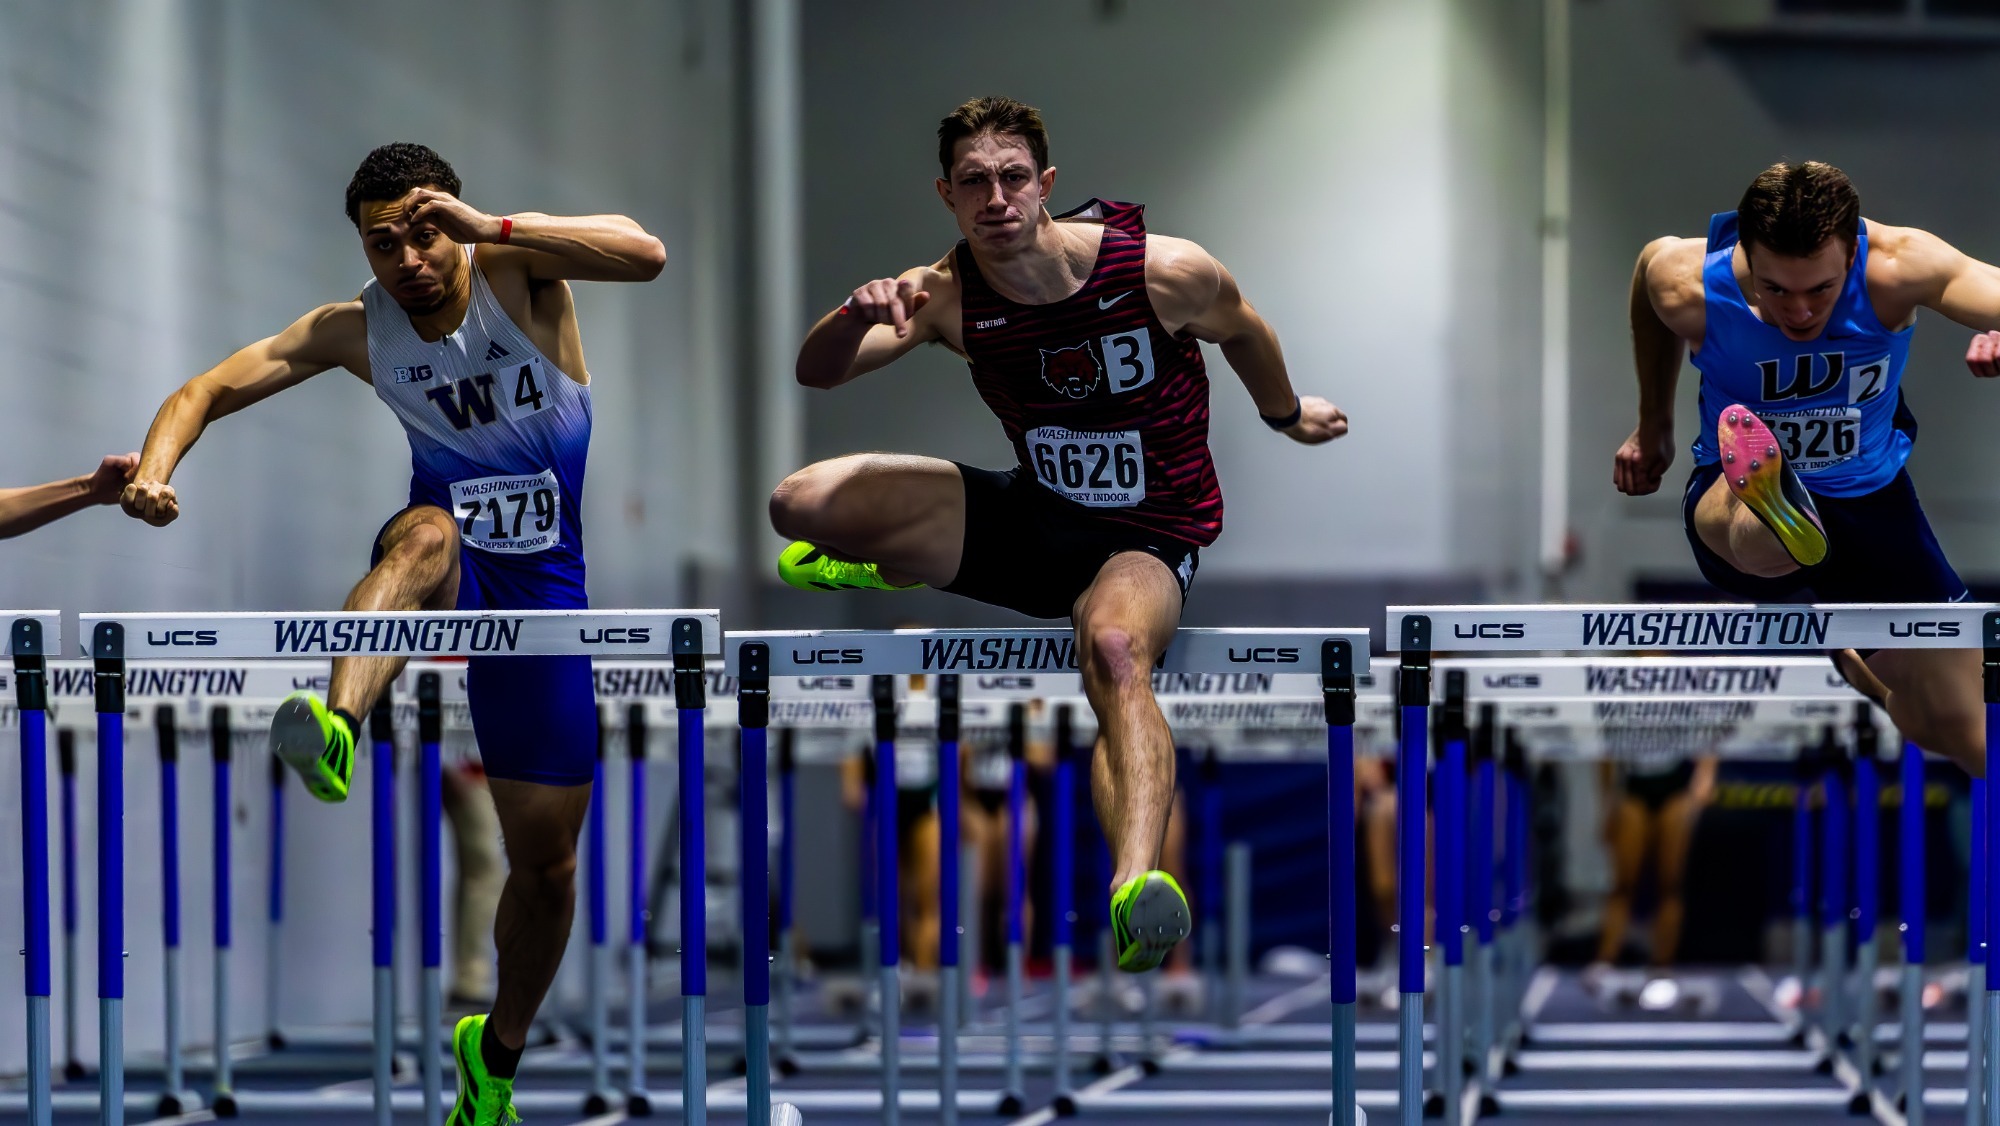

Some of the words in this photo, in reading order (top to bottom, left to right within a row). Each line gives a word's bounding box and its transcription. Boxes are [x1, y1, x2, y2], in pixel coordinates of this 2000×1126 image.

[976, 317, 1007, 329] CENTRAL
[1112, 335, 1145, 388] 3
[1755, 351, 1845, 402] W
[514, 363, 543, 411] 4
[1856, 364, 1882, 403] 2
[424, 373, 497, 432] W
[1764, 420, 1855, 460] 326
[1035, 443, 1138, 488] 6626
[461, 477, 546, 496] WASHINGTON
[1093, 493, 1130, 501] INDOOR
[460, 489, 555, 539] 7179
[517, 535, 548, 548] INDOOR
[147, 630, 218, 646] UCS
[274, 619, 523, 653] WASHINGTON
[580, 627, 650, 644] UCS
[1454, 623, 1525, 639] UCS
[1582, 612, 1833, 645] WASHINGTON
[1889, 621, 1961, 637] UCS
[792, 648, 864, 664] UCS
[920, 637, 1167, 670] WASHIN
[1228, 647, 1300, 663] UCS
[798, 675, 855, 690] UCS
[978, 676, 1035, 690] UCS
[1484, 673, 1541, 688] UCS
[1586, 665, 1783, 693] WASHINGTON
